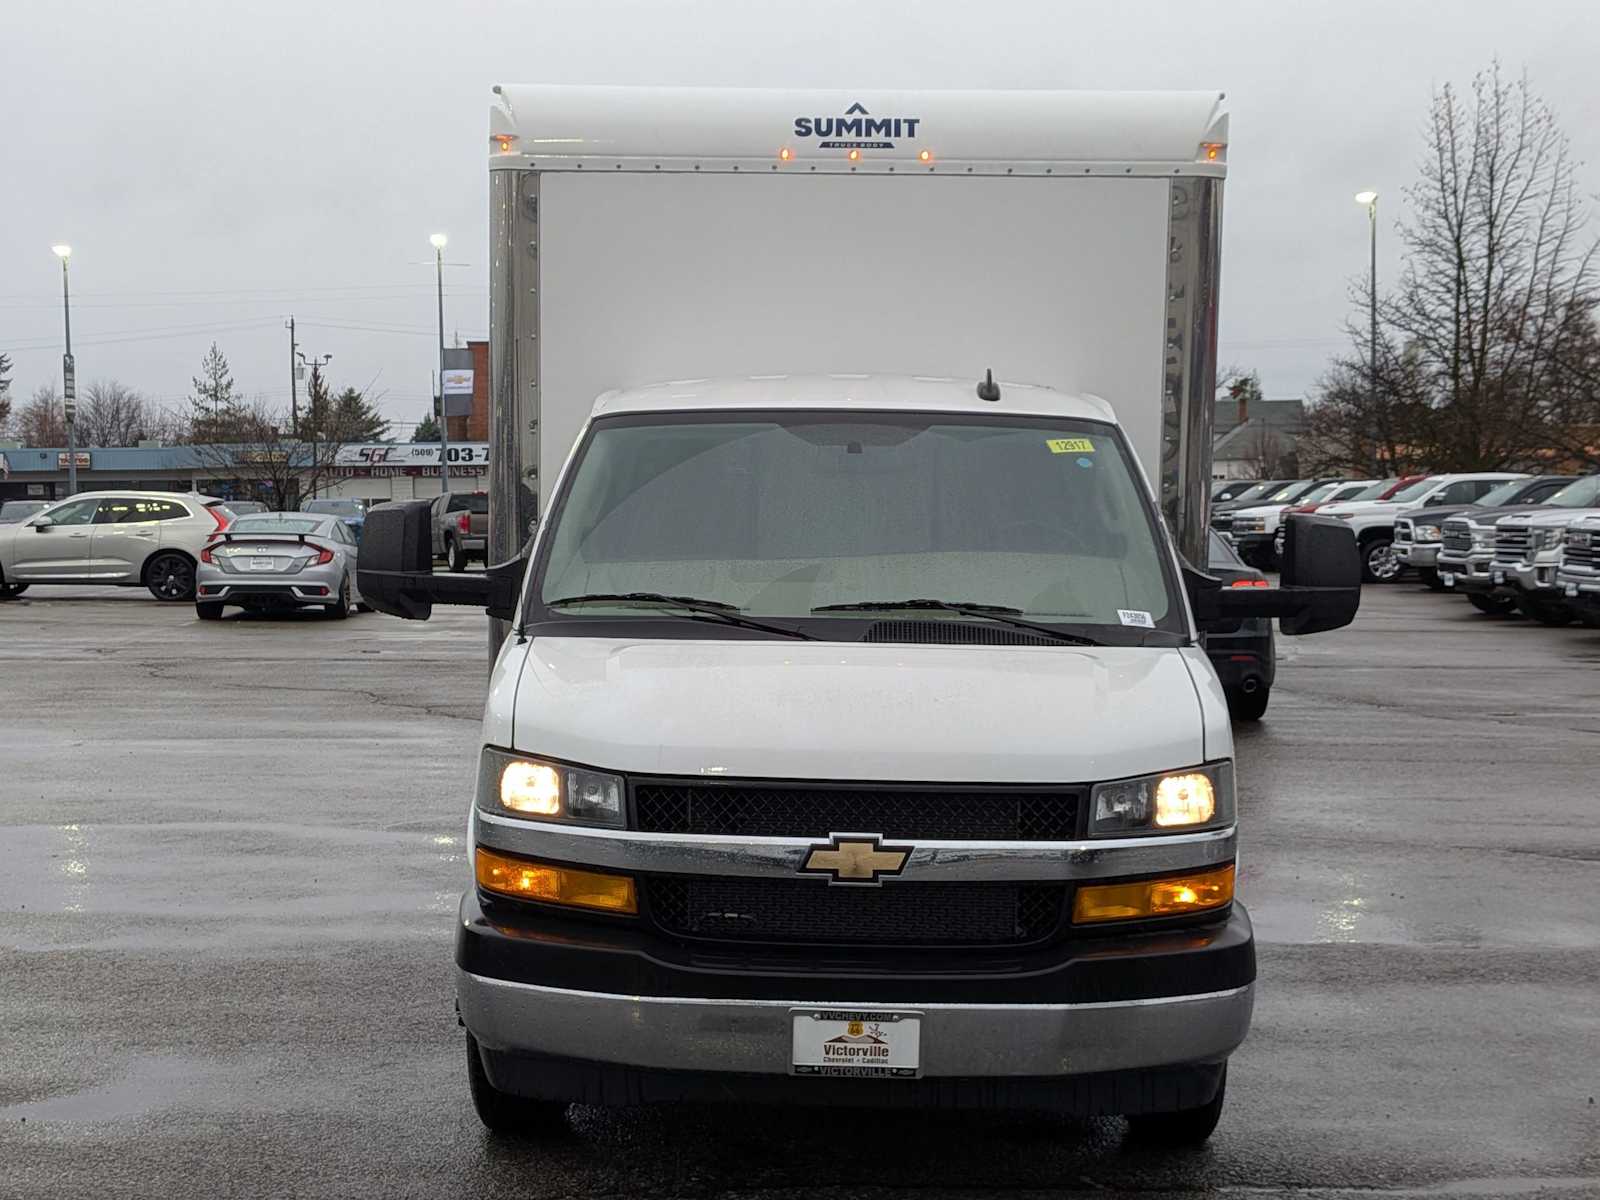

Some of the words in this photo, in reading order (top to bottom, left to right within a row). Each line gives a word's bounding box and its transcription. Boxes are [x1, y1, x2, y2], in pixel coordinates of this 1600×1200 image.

[794, 118, 920, 138] SUMMIT
[411, 447, 434, 457] (509)
[320, 466, 354, 477] AUTO
[370, 466, 407, 477] HOME
[823, 1044, 889, 1057] Victorville
[821, 1066, 892, 1077] VICTORVILLE
